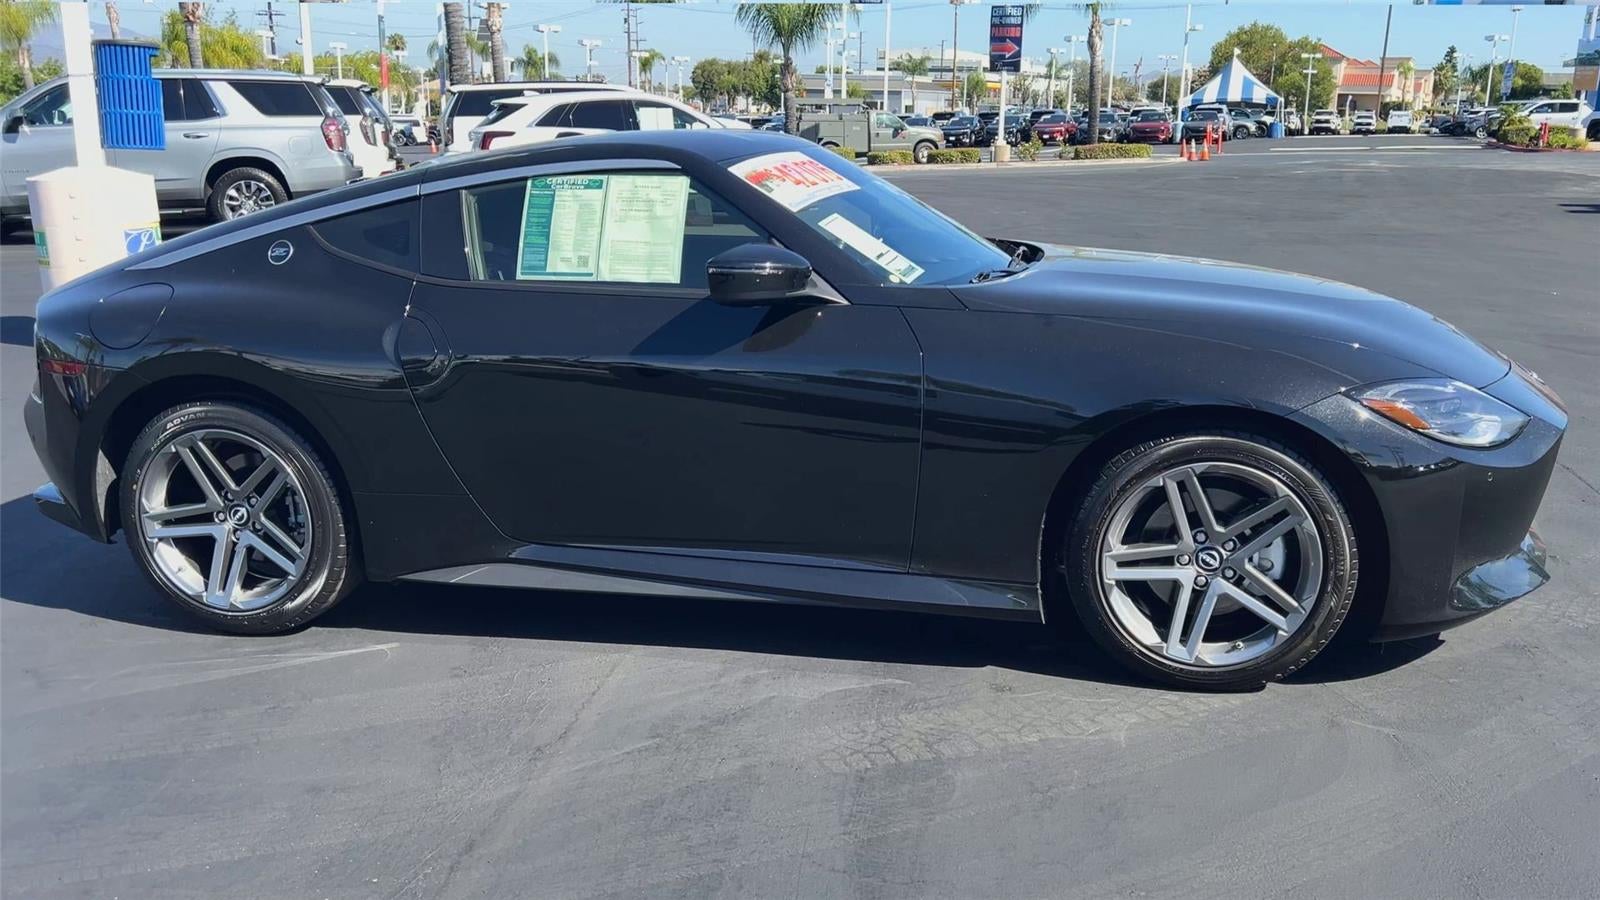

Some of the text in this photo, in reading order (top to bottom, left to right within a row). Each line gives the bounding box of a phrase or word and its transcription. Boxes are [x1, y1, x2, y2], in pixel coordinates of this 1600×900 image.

[992, 7, 1022, 16] CERTIFIED
[991, 16, 1021, 25] PRE-OWNED
[991, 26, 1021, 37] PARKING
[546, 177, 589, 185] CERTIFIED
[166, 412, 206, 430] ADVAN
